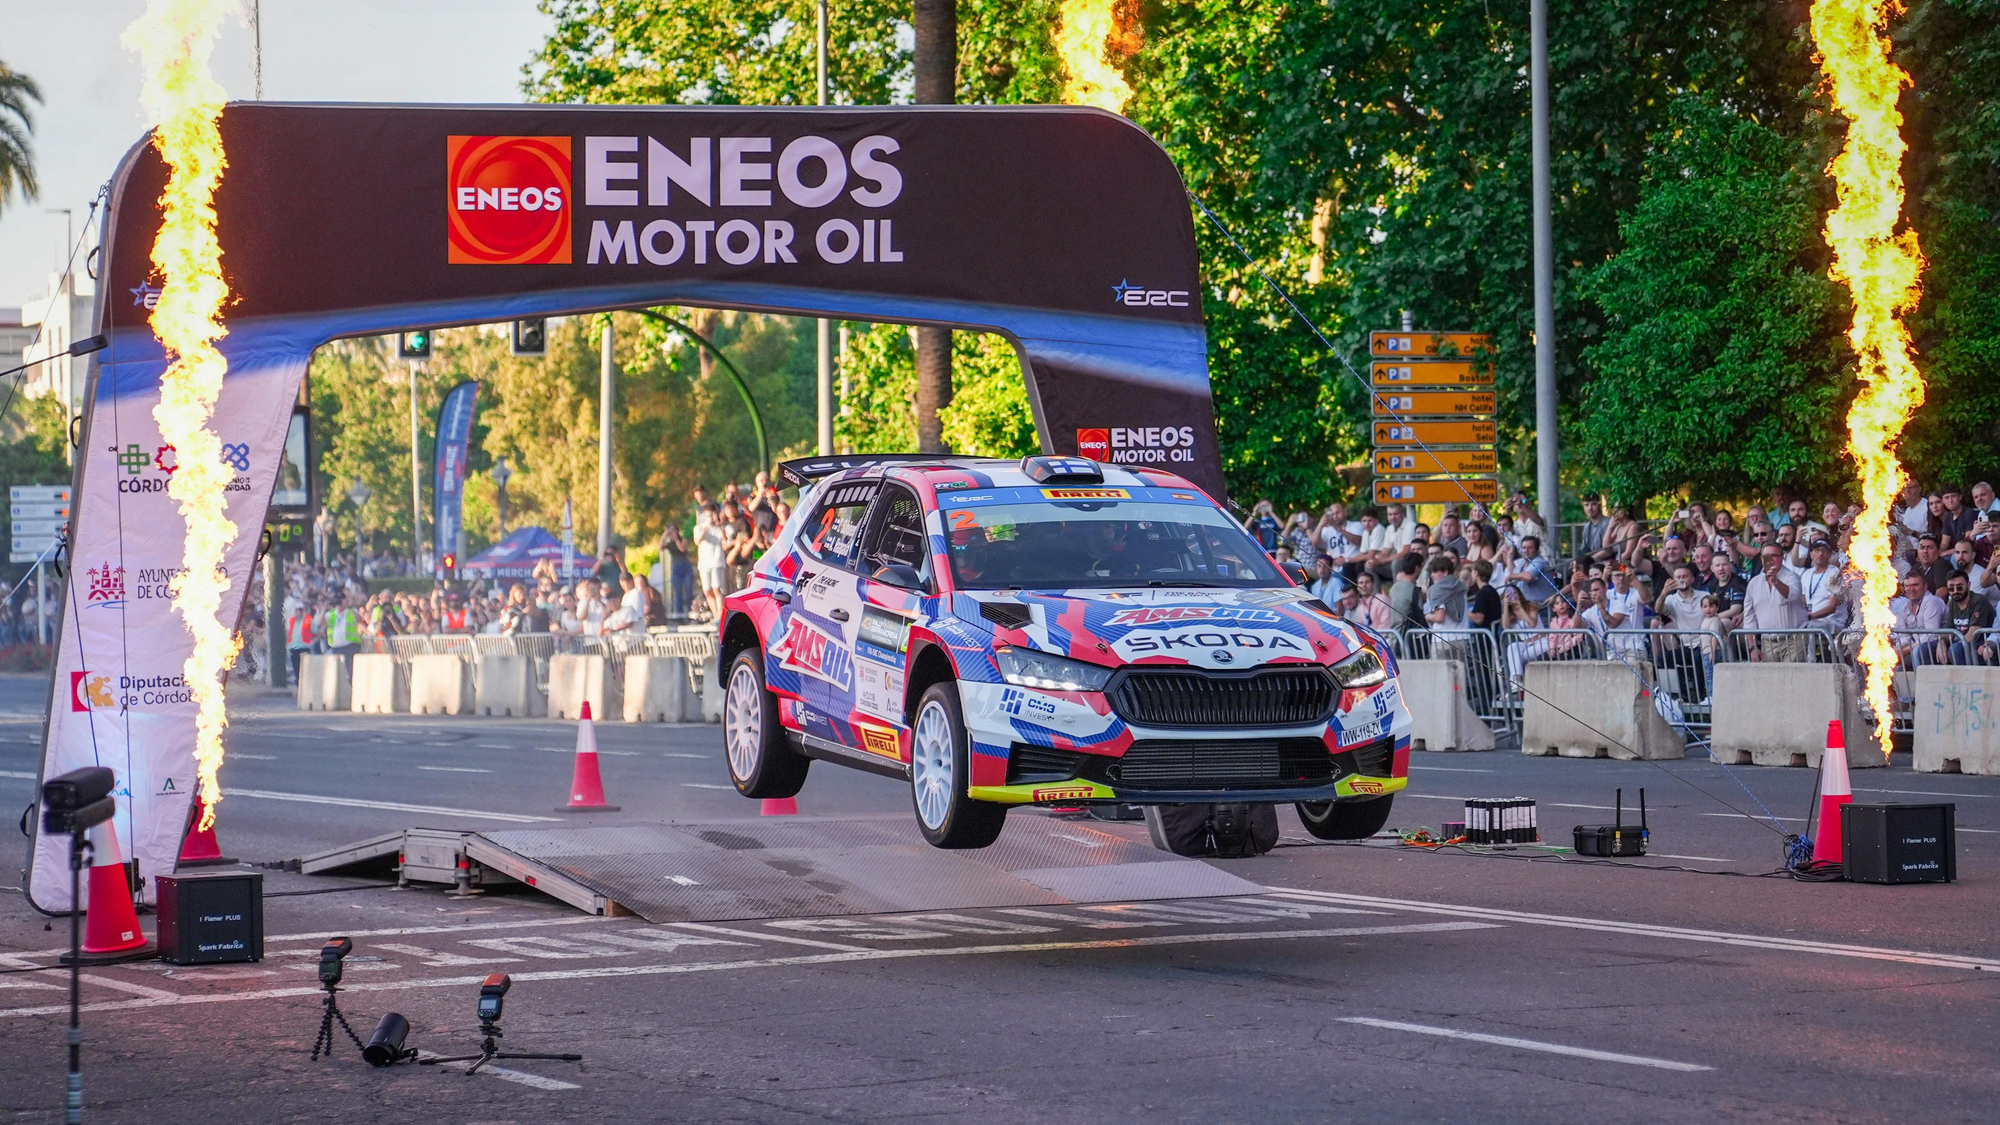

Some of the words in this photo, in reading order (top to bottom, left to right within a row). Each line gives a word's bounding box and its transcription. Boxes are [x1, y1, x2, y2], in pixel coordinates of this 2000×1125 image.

[585, 135, 904, 208] ENEOS
[457, 187, 562, 211] ENEOS
[587, 219, 797, 266] MOTOR
[815, 218, 904, 265] OIL
[1123, 290, 1189, 307] ERC
[1459, 374, 1490, 382] Boston
[1471, 395, 1493, 403] hotel
[1469, 404, 1493, 412] Califa
[1472, 424, 1493, 432] hotel
[1111, 426, 1194, 447] ENEOS
[1080, 441, 1107, 449] ENEOS
[1112, 449, 1167, 463] MOTOR
[1170, 448, 1194, 462] OIL
[1458, 463, 1494, 471] González
[119, 477, 171, 493] CÓRD
[1473, 483, 1494, 491] hotel
[1049, 489, 1122, 498] PIRELLI
[949, 511, 979, 530] 2
[810, 507, 835, 552] 2
[138, 585, 152, 599] DE
[1112, 607, 1279, 626] AMSOIL
[958, 631, 981, 649] INVEST
[775, 615, 853, 690] AMSOIL
[120, 673, 187, 692] Diputaci
[120, 691, 138, 706] de
[1027, 698, 1056, 714] CM3
[1024, 708, 1055, 722] INVEST
[863, 728, 897, 754] PIRELLI
[1342, 721, 1381, 745] WW-119-ZY
[1032, 786, 1094, 802] PIRELLI
[1349, 782, 1384, 794] PIRELLI
[1918, 862, 1939, 870] Fabrica
[198, 943, 217, 952] Spark
[218, 942, 244, 950] Fabrica
